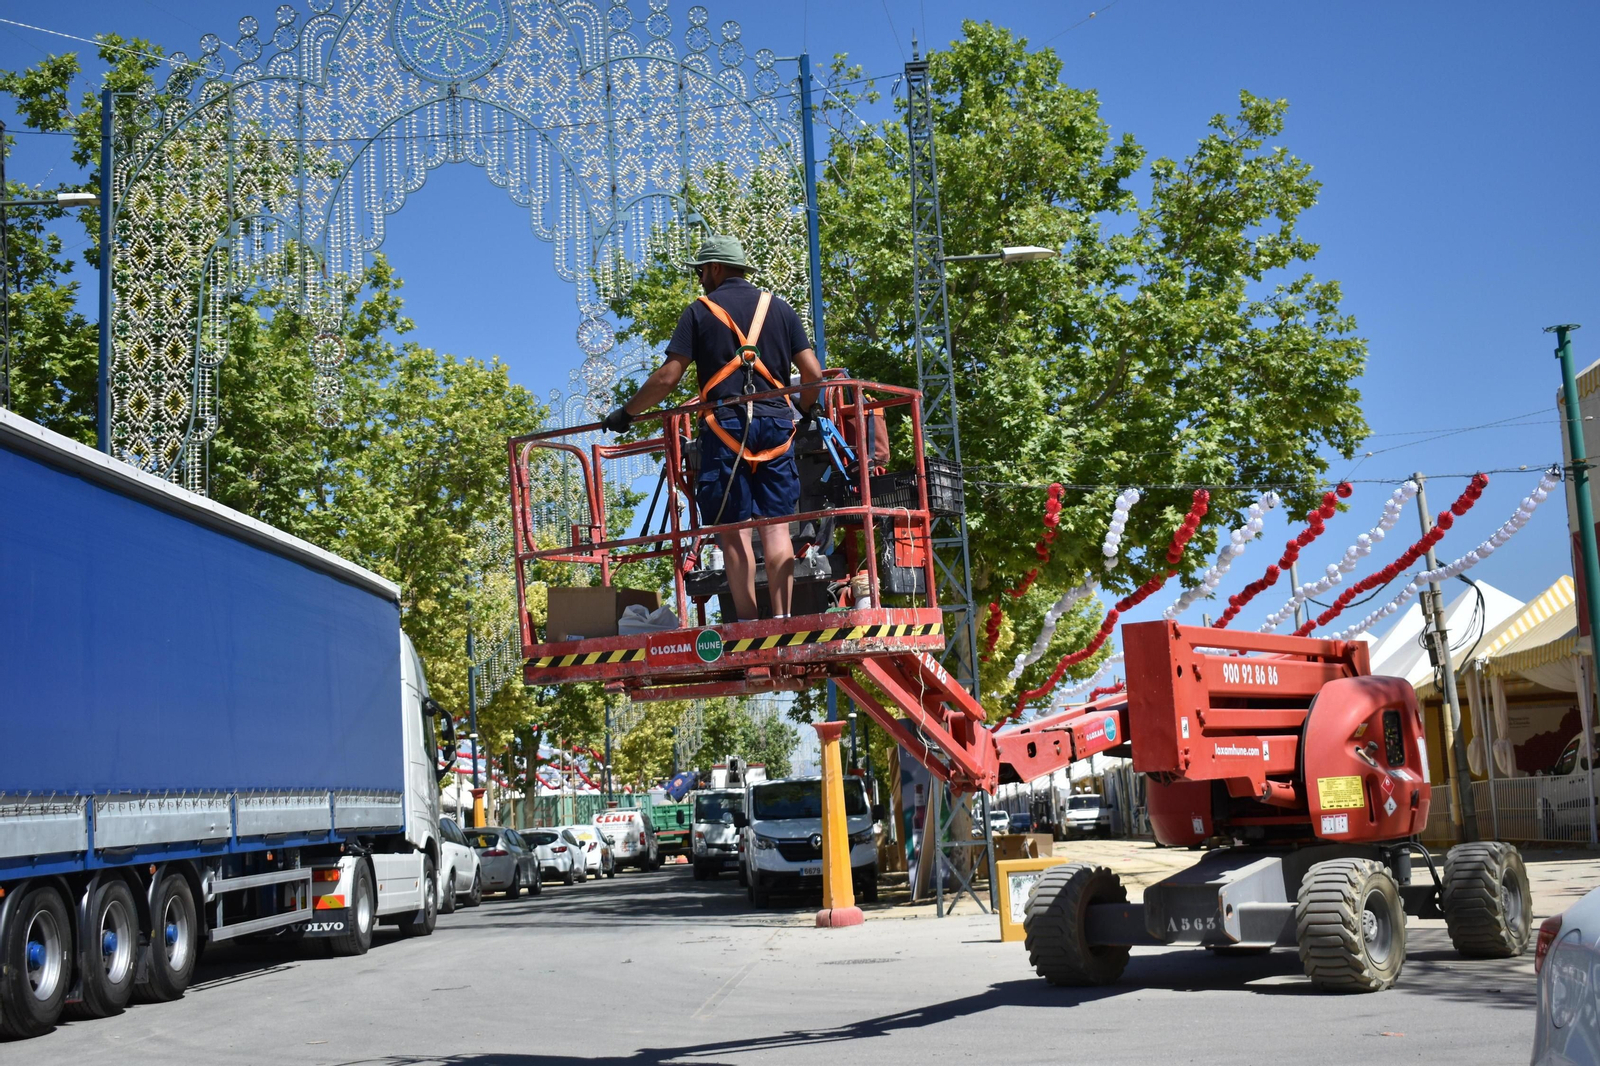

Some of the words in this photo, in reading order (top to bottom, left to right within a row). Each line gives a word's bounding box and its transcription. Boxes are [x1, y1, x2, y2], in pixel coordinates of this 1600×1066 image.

[698, 641, 721, 650] HUNE
[1223, 662, 1240, 684] 900
[1241, 663, 1253, 684] 92
[1255, 664, 1266, 685] 86
[1267, 665, 1278, 686] 86
[1214, 742, 1260, 756] loxamhune.com
[596, 814, 635, 824] CENIT
[804, 867, 821, 875] 6679
[289, 921, 345, 932] VOLVO
